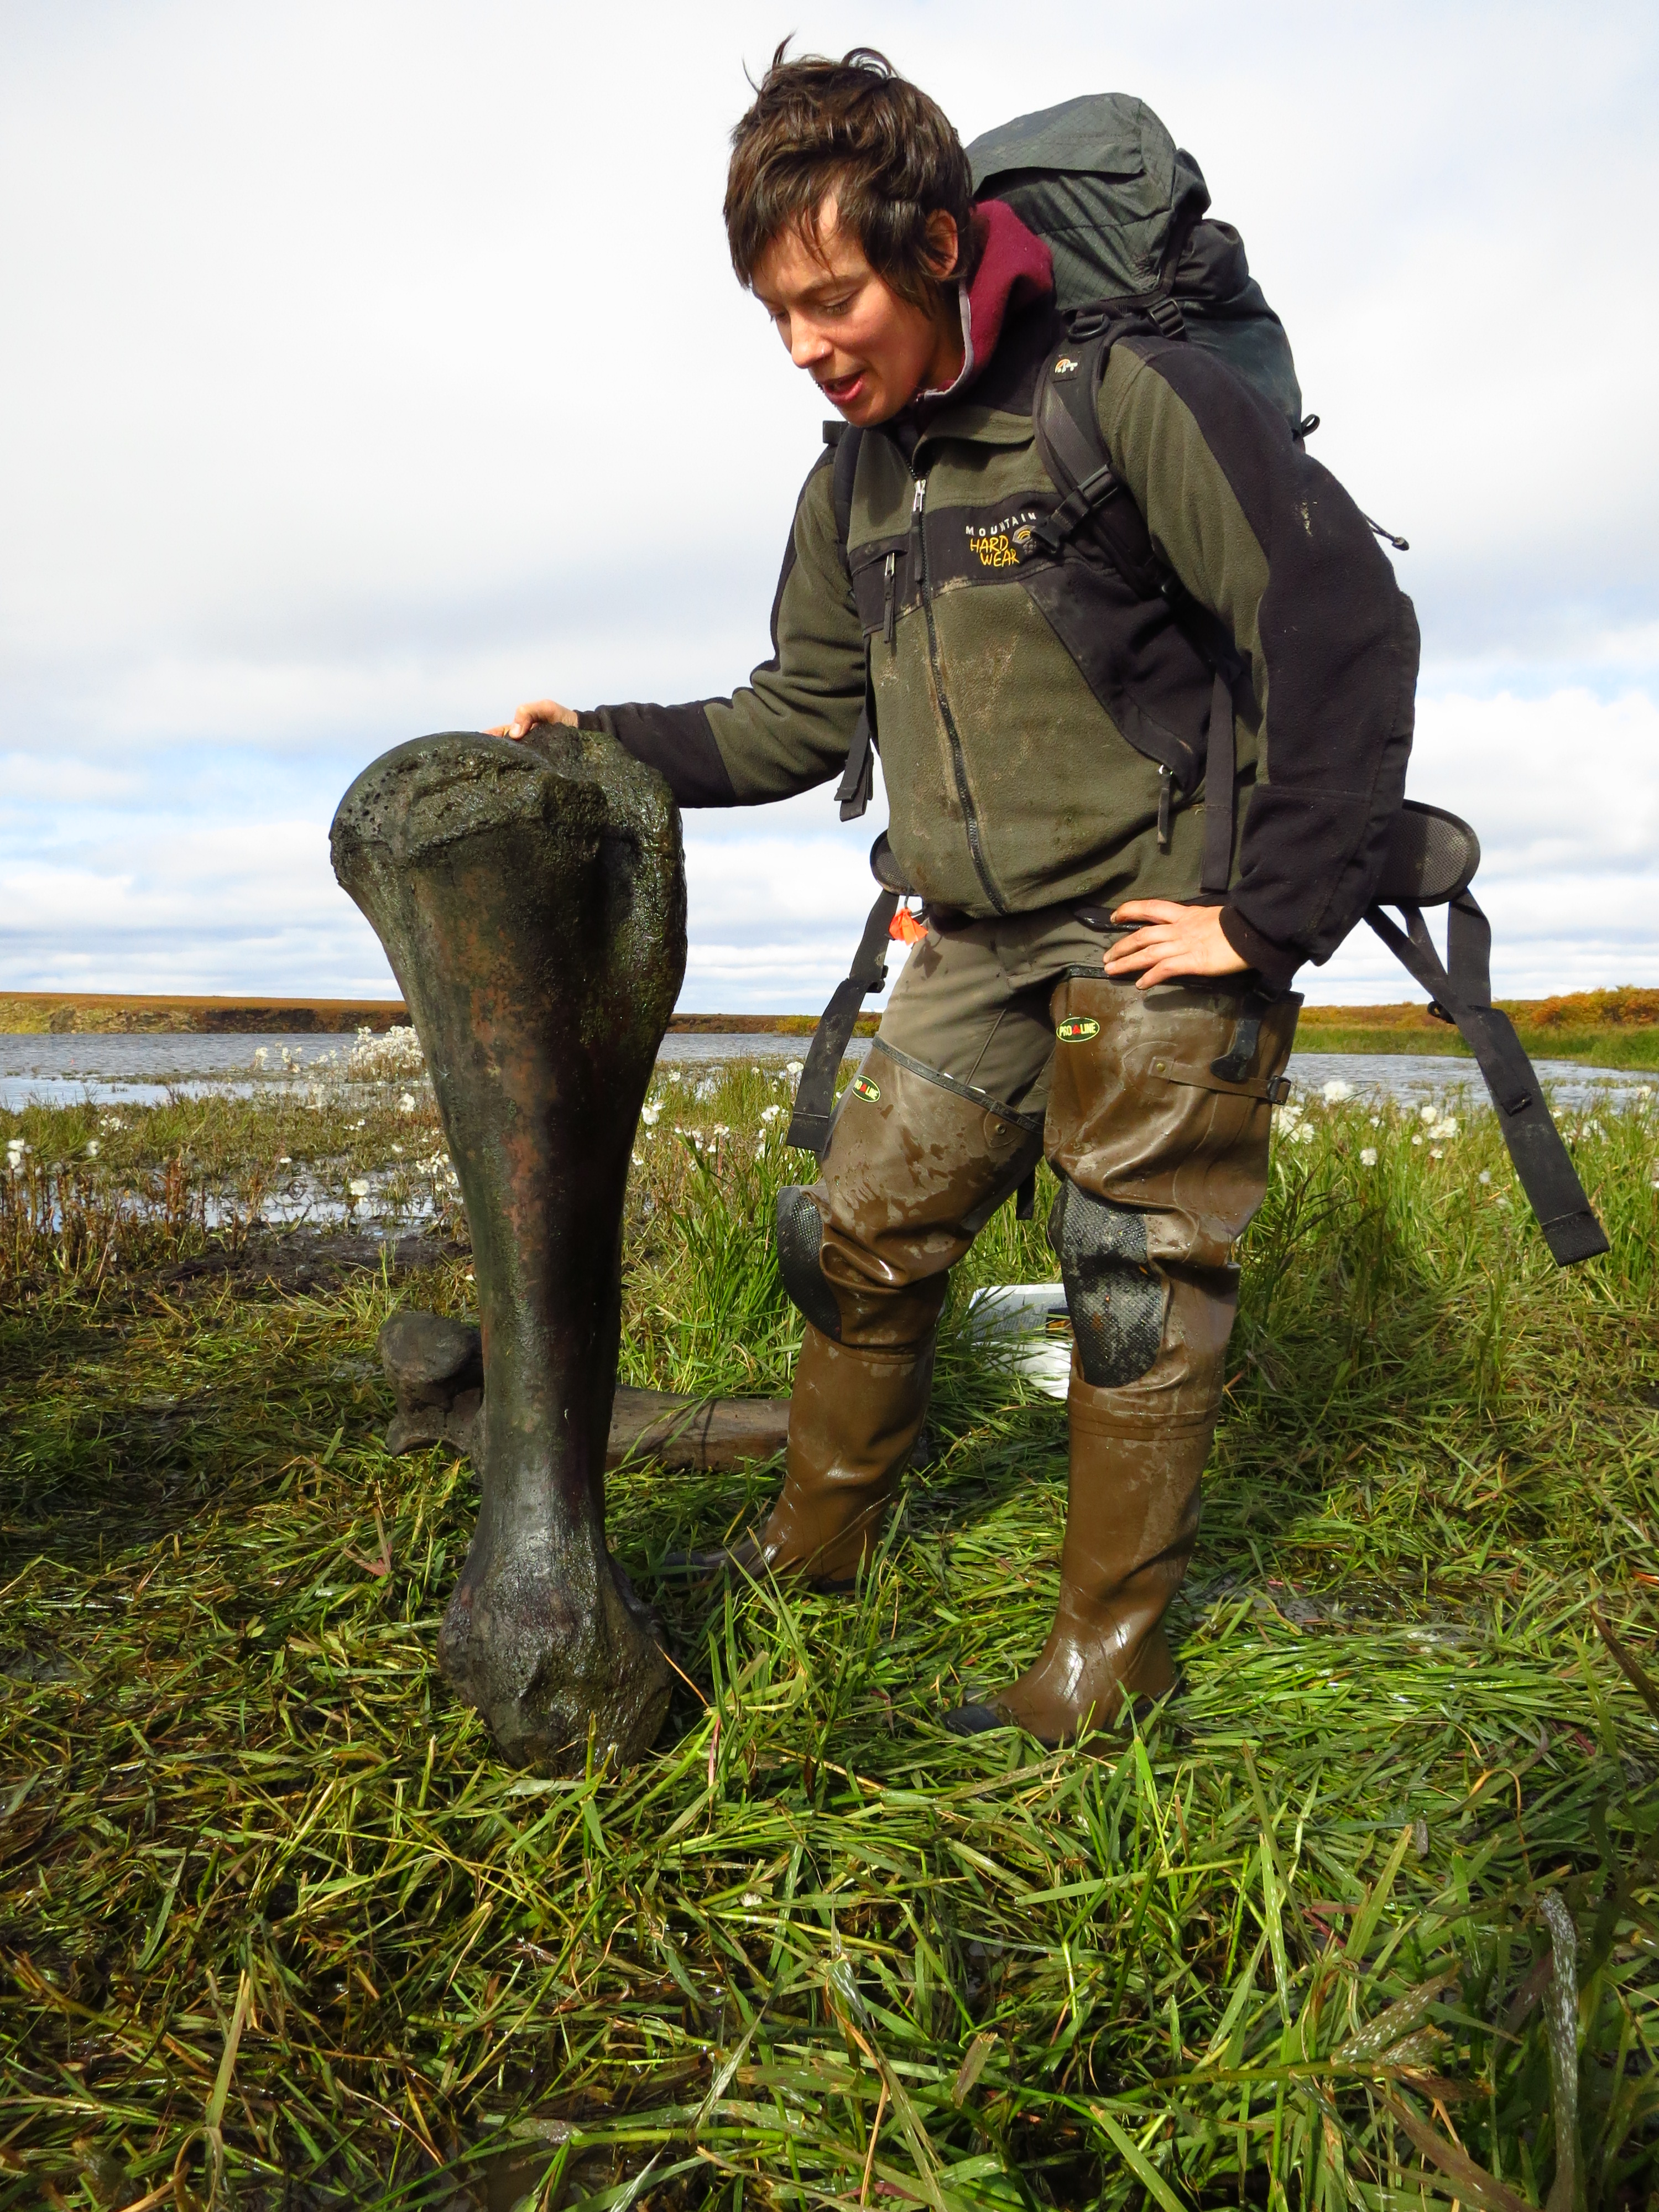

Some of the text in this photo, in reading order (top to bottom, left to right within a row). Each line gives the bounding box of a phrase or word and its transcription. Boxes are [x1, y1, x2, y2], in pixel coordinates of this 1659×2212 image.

[966, 512, 1037, 536] MOUNTAIN
[970, 535, 1009, 553] HARD
[980, 549, 1020, 567] WEAR
[1059, 1022, 1096, 1037] PRO LINE
[865, 1086, 879, 1100] LINE
